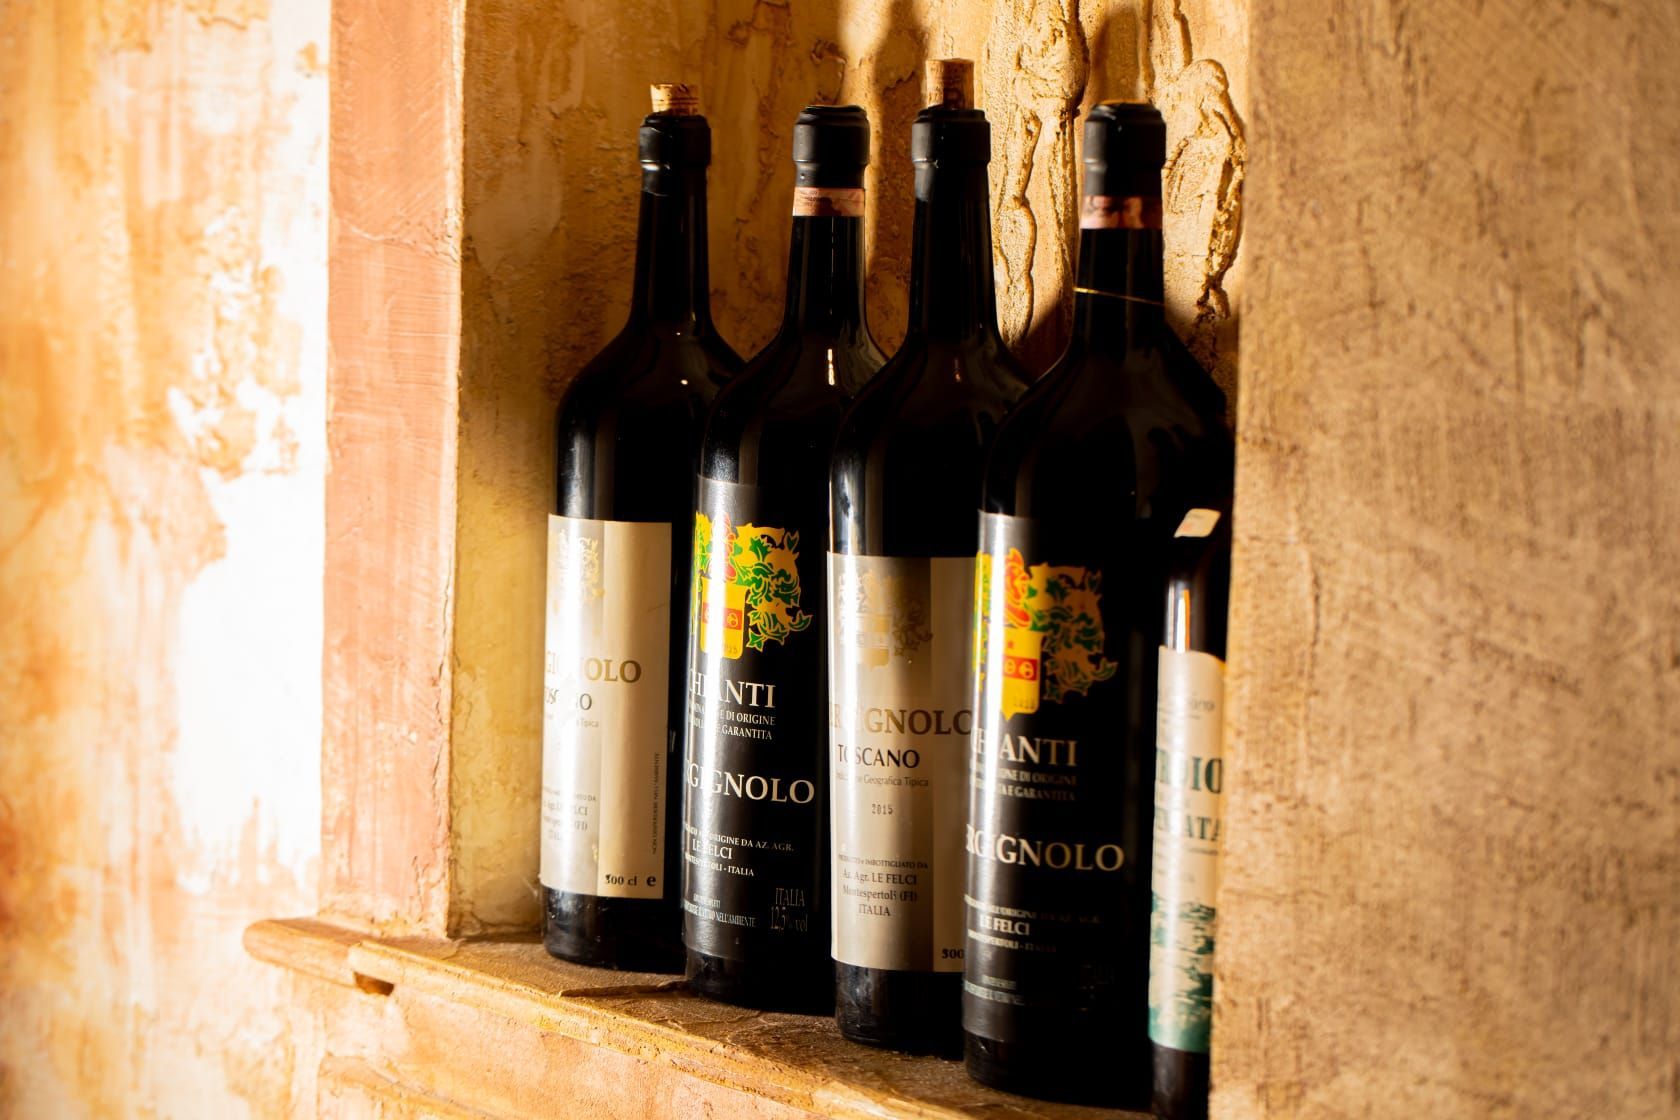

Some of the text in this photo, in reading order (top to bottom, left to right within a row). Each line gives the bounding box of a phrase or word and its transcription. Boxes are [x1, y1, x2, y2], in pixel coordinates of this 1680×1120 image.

[726, 709, 735, 721] DI
[736, 712, 776, 726] ORIGINE
[721, 724, 773, 740] GARANTITA
[741, 838, 753, 848] DA
[728, 865, 754, 877] ITALIA
[871, 872, 884, 883] LE
[885, 873, 917, 886] FELCI
[858, 903, 891, 917] ITALIA
[993, 916, 1031, 936] FELCI
